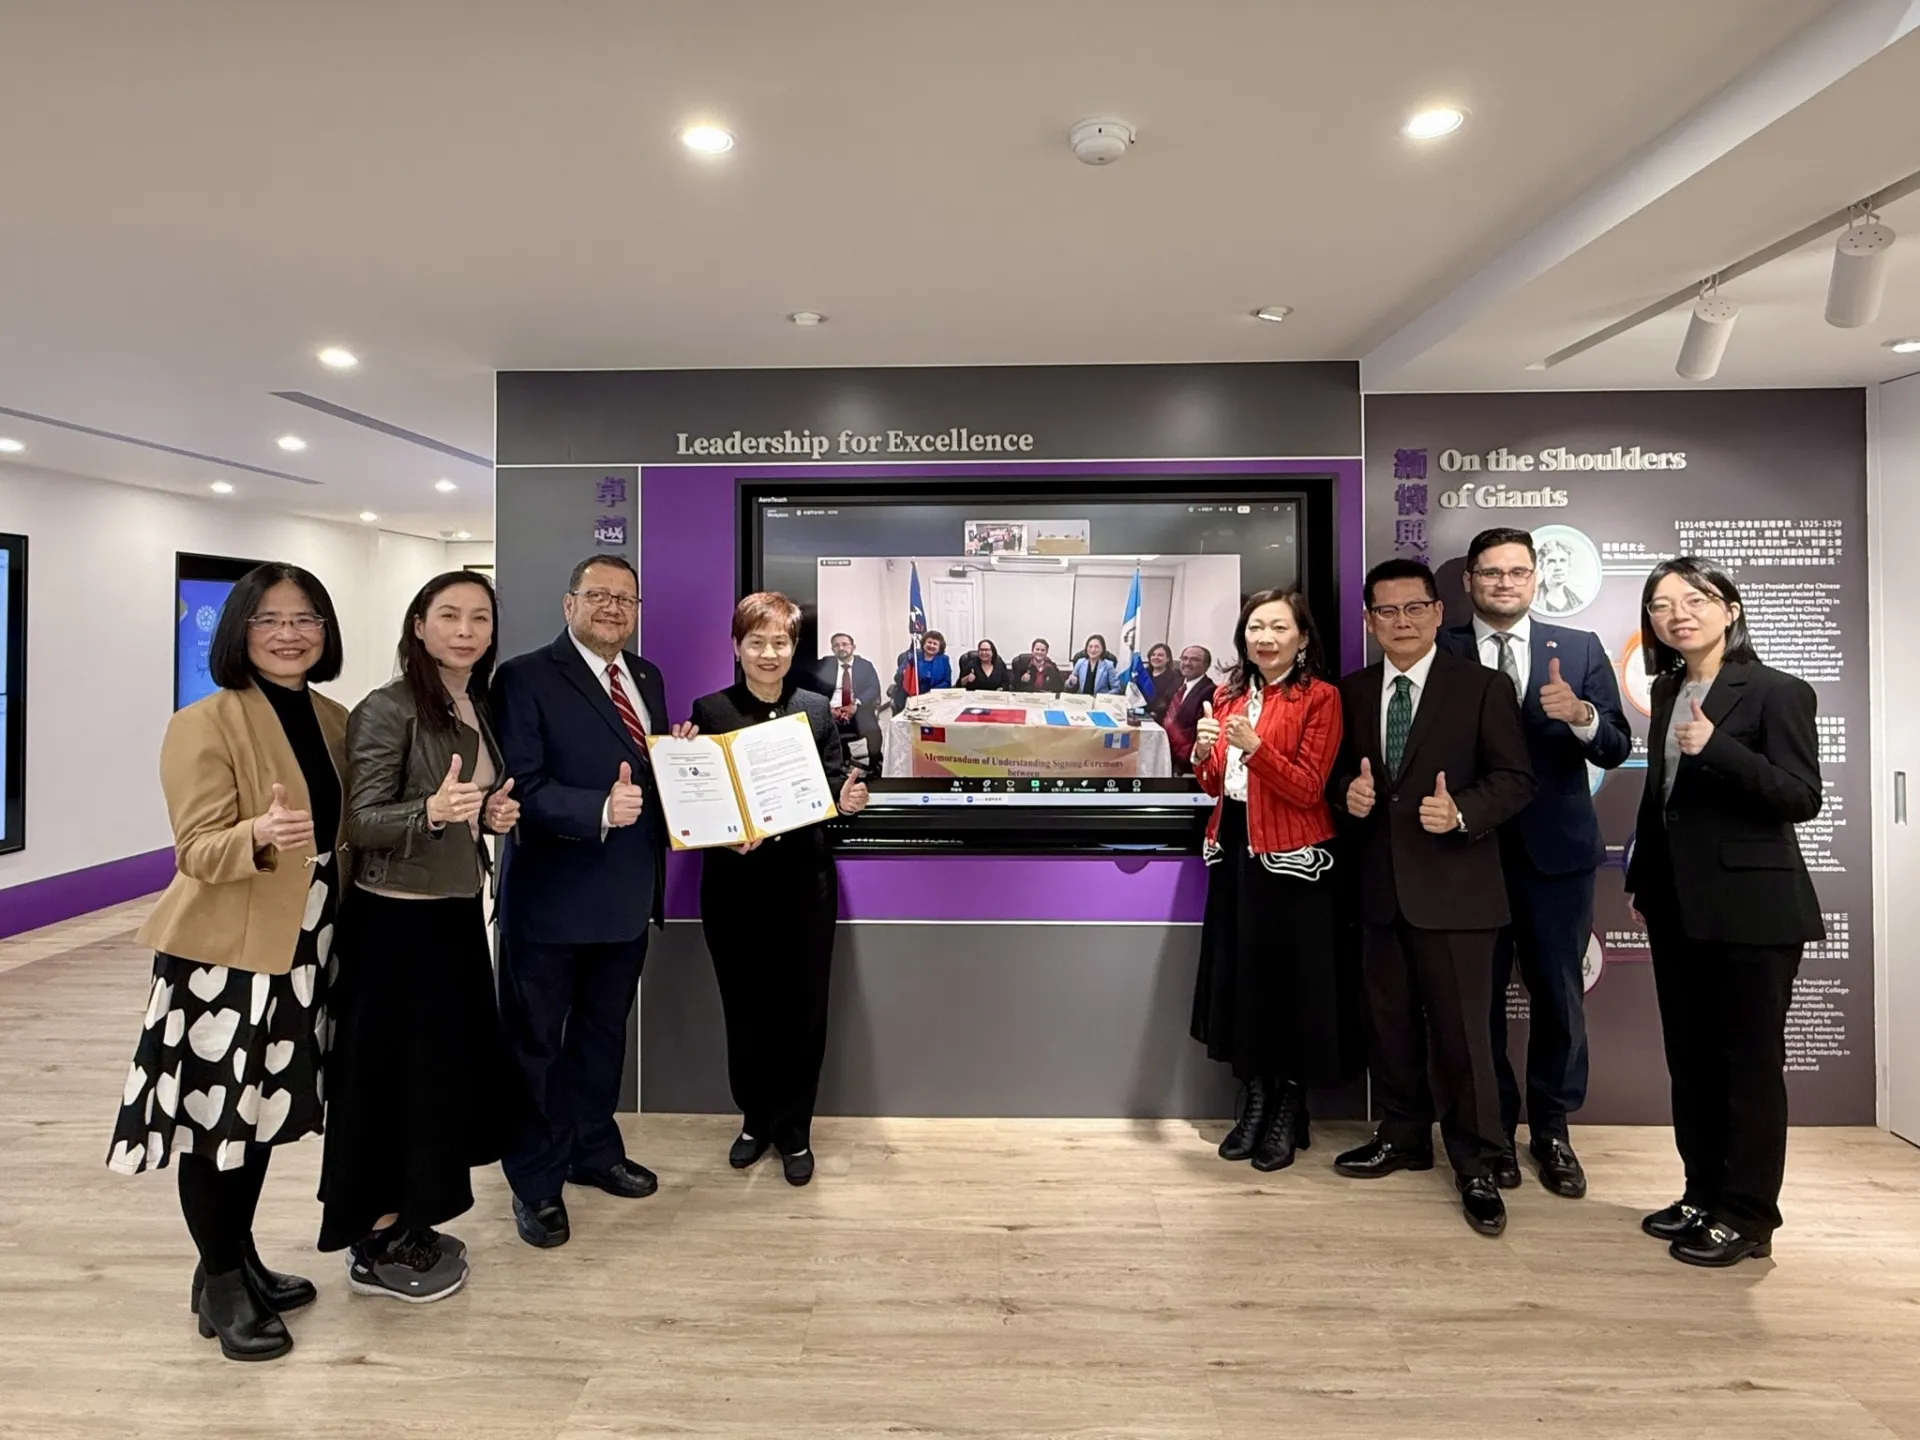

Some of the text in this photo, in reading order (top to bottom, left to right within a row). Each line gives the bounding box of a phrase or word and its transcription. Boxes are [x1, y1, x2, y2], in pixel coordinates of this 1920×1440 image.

[676, 428, 1033, 460] Leadership for Excellence
[1439, 447, 1687, 472] On the Shoulders
[1394, 448, 1429, 566] 緬懷與
[1439, 482, 1568, 508] of Giants
[595, 476, 628, 554] 卓越
[1810, 652, 1829, 660] China
[1830, 652, 1842, 660] and
[924, 752, 1124, 772] Memorandum of Understanding Signing Ceremony
[1008, 767, 1039, 777] between
[1799, 987, 1824, 995] Medical
[1825, 987, 1850, 995] College
